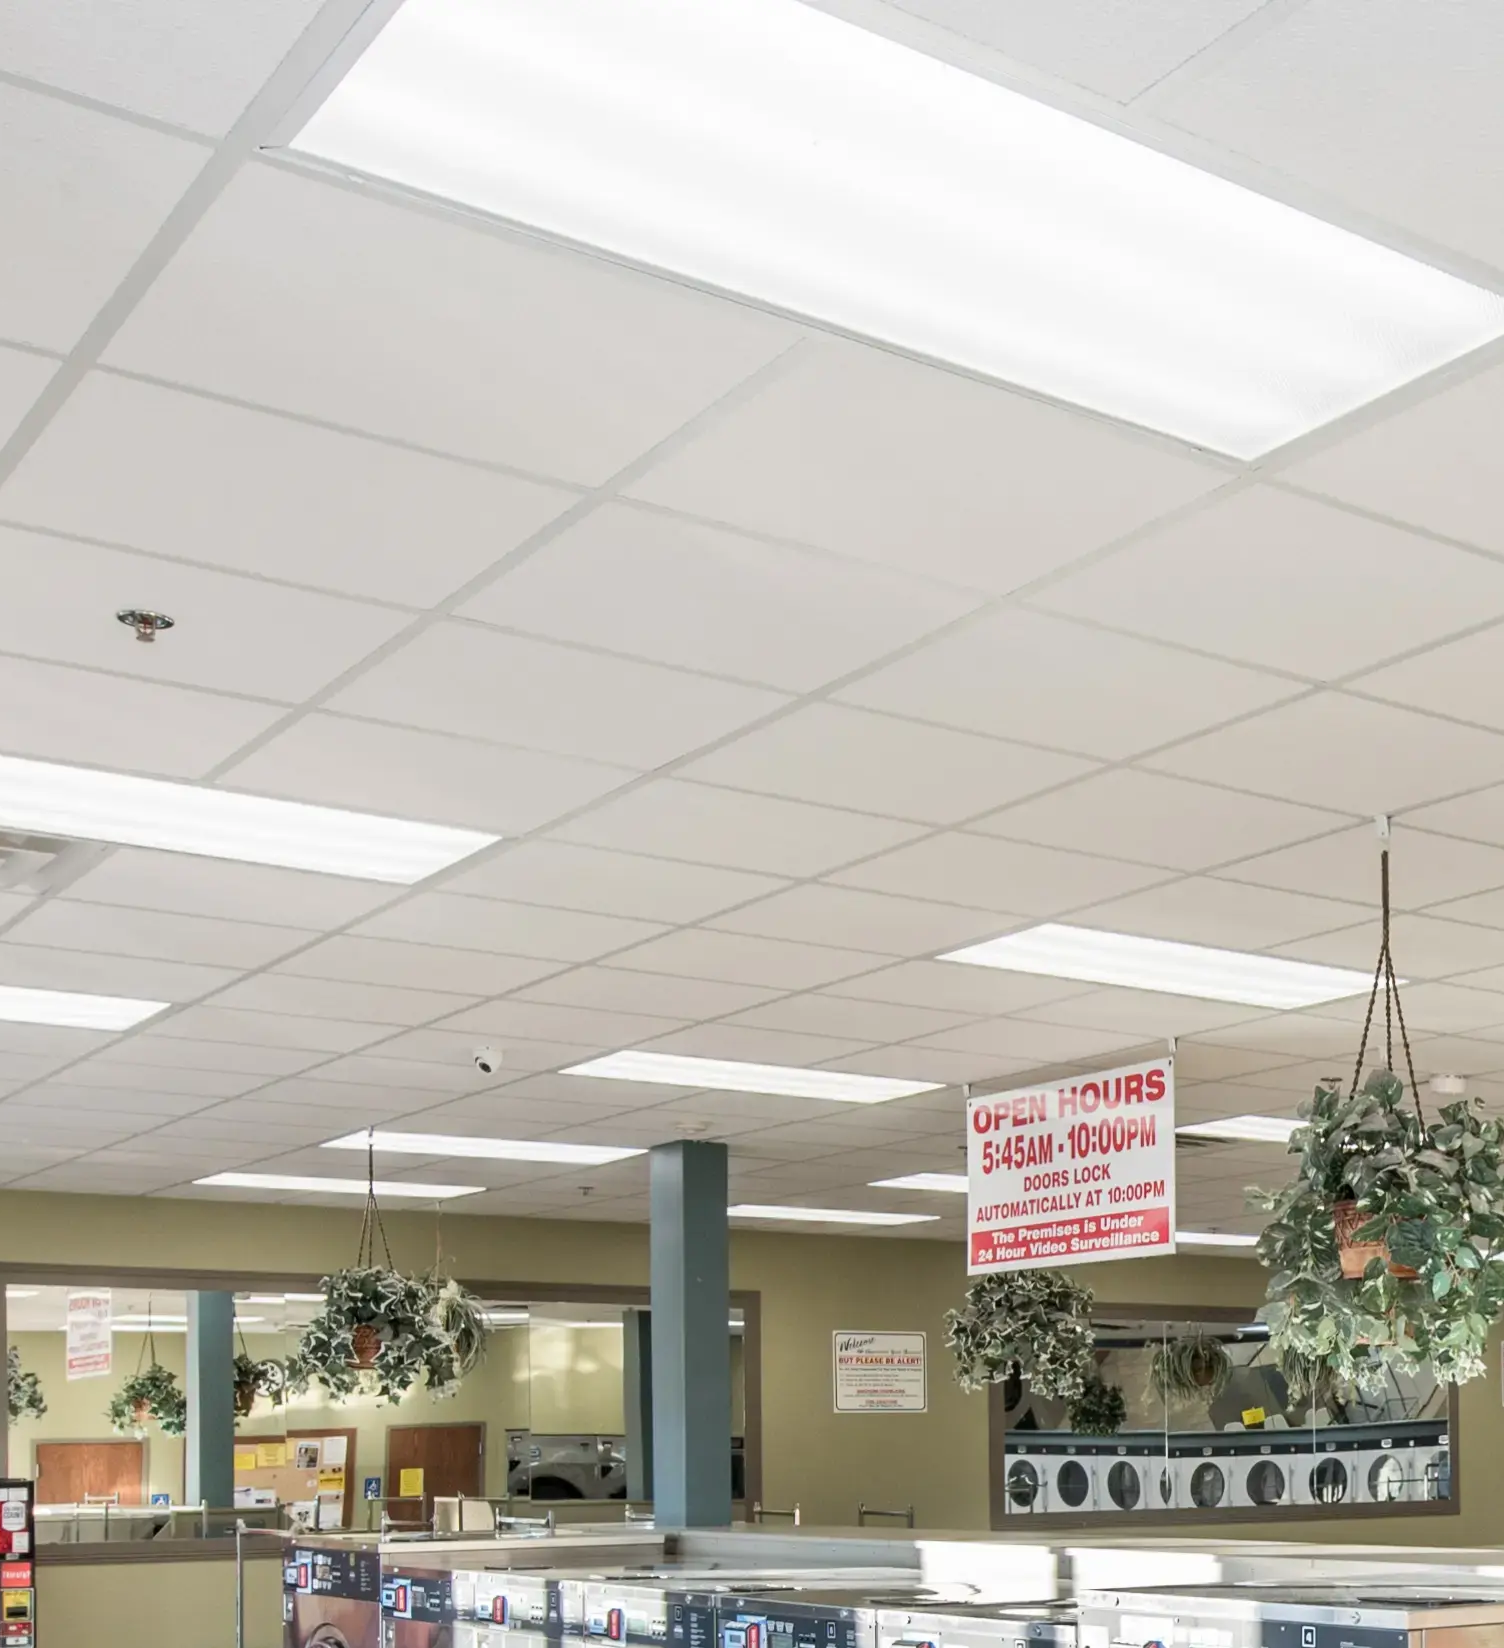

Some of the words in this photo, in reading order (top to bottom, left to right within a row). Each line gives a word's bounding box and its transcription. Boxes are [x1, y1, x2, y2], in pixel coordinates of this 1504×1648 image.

[973, 1093, 1046, 1134] OPEN
[1058, 1069, 1166, 1118] HOURS
[982, 1133, 1053, 1175] 5:45AM
[1068, 1114, 1156, 1159] 10:00PM
[1023, 1170, 1069, 1192] DOORS
[1074, 1163, 1111, 1185] LOCK
[976, 1192, 1081, 1223] AUTOMATICALLY
[1085, 1189, 1102, 1207] AT
[1107, 1180, 1165, 1204] 10:00PM
[978, 1248, 993, 1263] 24
[996, 1244, 1026, 1260] Hour
[1029, 1240, 1067, 1257] Video
[1070, 1229, 1160, 1251] Surveillance
[992, 1232, 1014, 1245] The
[1018, 1222, 1080, 1241] Premises
[1084, 1219, 1096, 1233] is
[1100, 1214, 1144, 1230] Under
